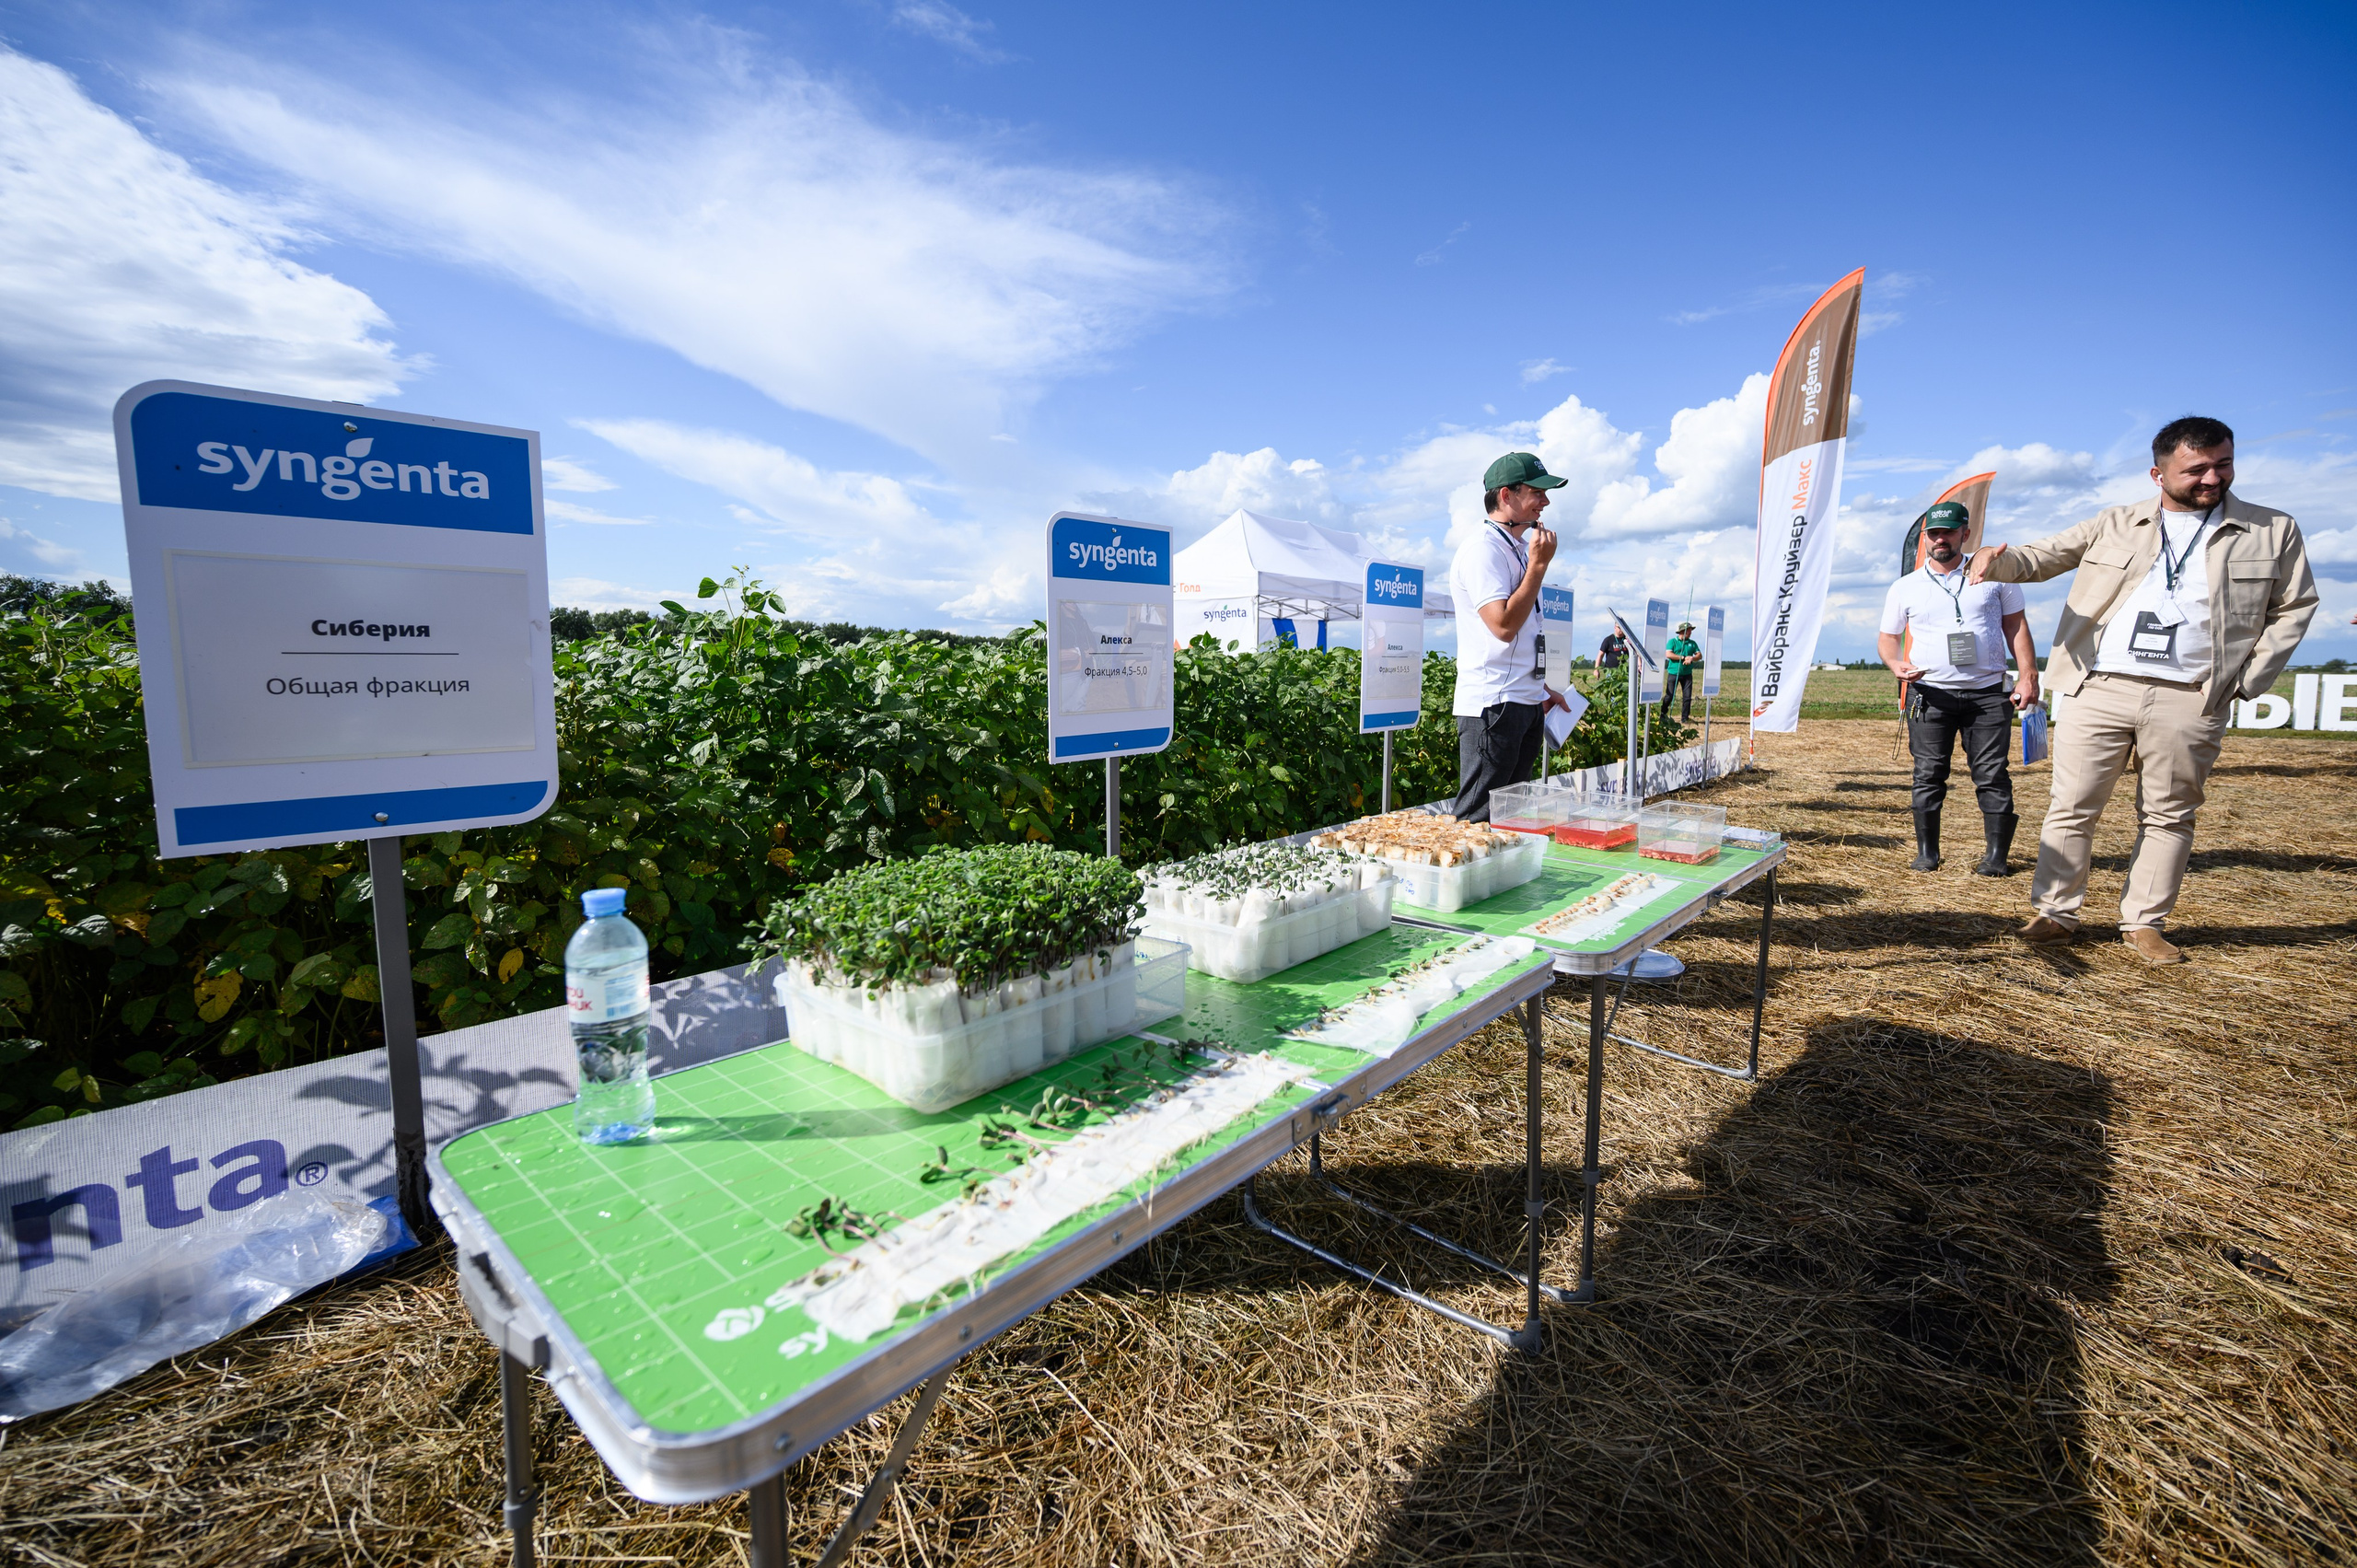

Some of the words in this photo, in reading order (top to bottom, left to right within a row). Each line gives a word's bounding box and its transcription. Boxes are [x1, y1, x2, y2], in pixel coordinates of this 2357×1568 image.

[196, 438, 491, 501] syngenta
[1792, 459, 1812, 510] Макс
[1069, 538, 1157, 571] syngenta
[1179, 582, 1201, 593] Голд
[1375, 577, 1417, 599] syngenta
[1203, 607, 1247, 622] syngenta
[1543, 598, 1570, 614] syngenta
[1649, 609, 1666, 622] syngenta
[311, 619, 431, 642] Сиберия
[1100, 634, 1132, 645] Алекса
[2127, 650, 2170, 659] СИНГЕНТА
[1084, 667, 1120, 679] Фракция
[266, 677, 358, 698] Общая
[366, 677, 470, 698] фракция
[2227, 673, 2357, 732] ЫЕ
